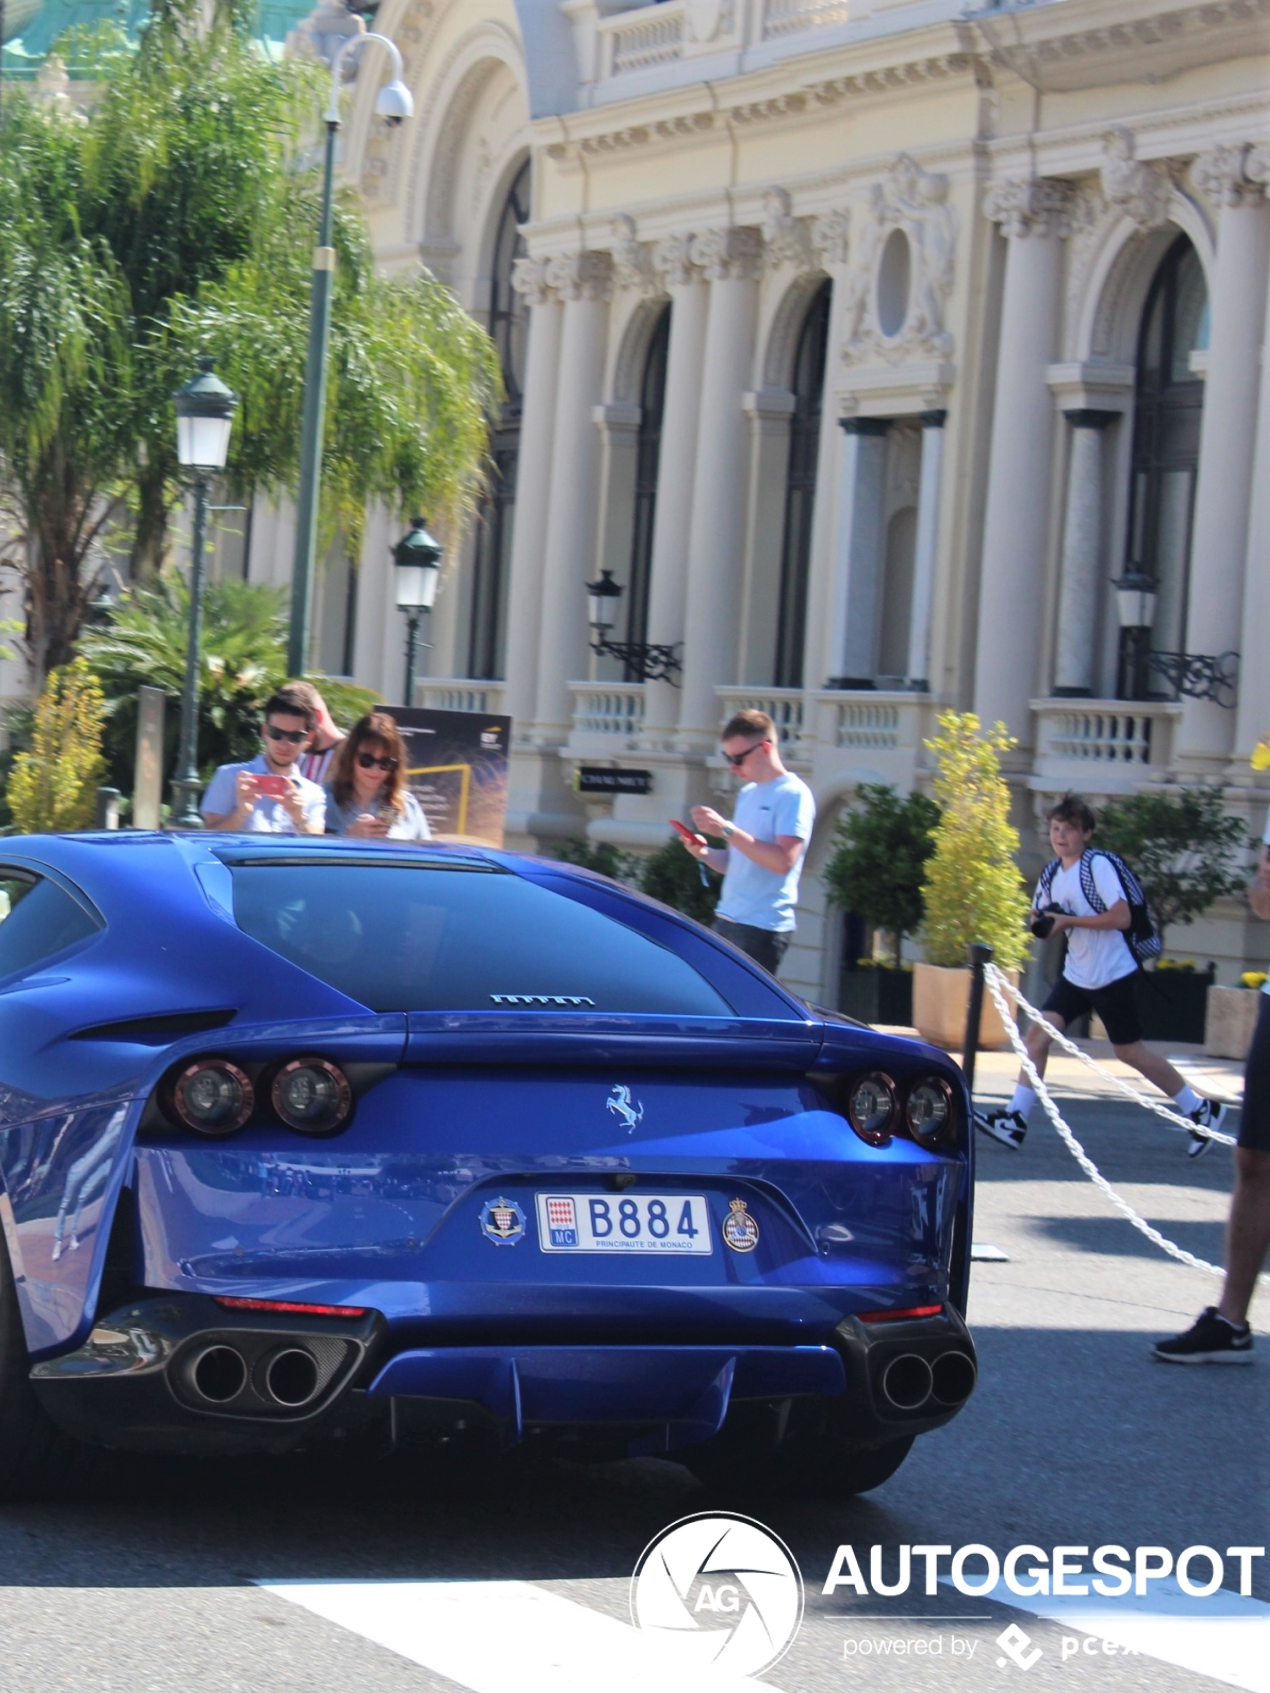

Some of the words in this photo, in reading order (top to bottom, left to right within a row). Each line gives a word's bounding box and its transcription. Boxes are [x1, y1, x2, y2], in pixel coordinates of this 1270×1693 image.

[588, 1198, 698, 1239] B884
[555, 1231, 573, 1244] MC
[595, 1240, 646, 1249] PRINCIPAUTE
[647, 1241, 658, 1249] DE
[660, 1241, 693, 1249] MONACO
